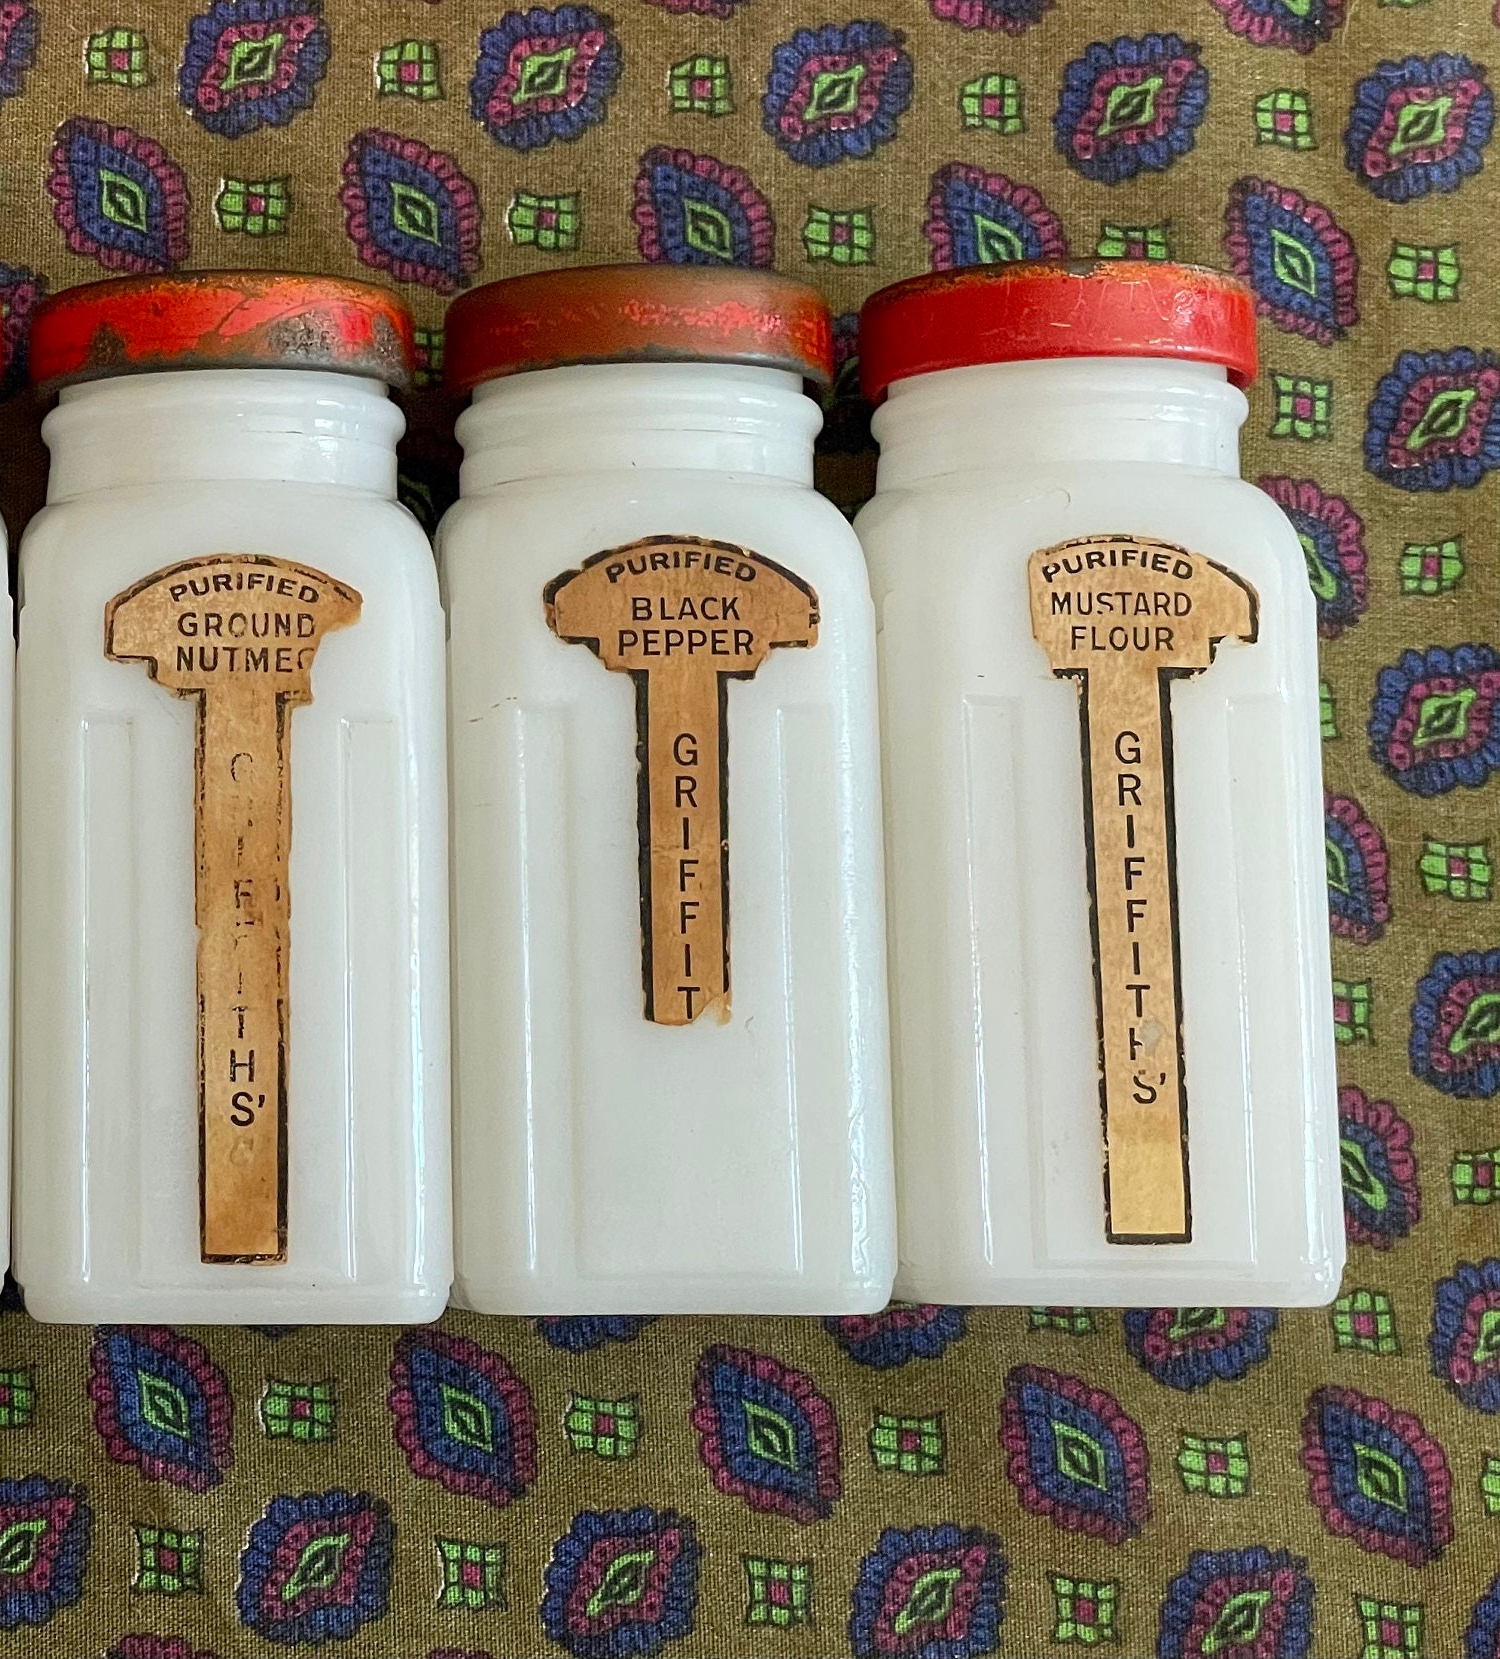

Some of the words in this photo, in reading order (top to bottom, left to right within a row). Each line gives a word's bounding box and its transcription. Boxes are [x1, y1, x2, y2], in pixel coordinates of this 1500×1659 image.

[605, 551, 757, 583] PURIFIED
[1042, 550, 1193, 583] PURIFIED
[169, 573, 320, 604] PURIFIED
[631, 597, 741, 621] BLACK
[1051, 591, 1192, 617] MUSTARD
[177, 612, 316, 638] GROUND
[1071, 626, 1175, 651] FLOUR
[618, 629, 754, 656] PEPPER
[672, 733, 700, 1019] GRIFFIT
